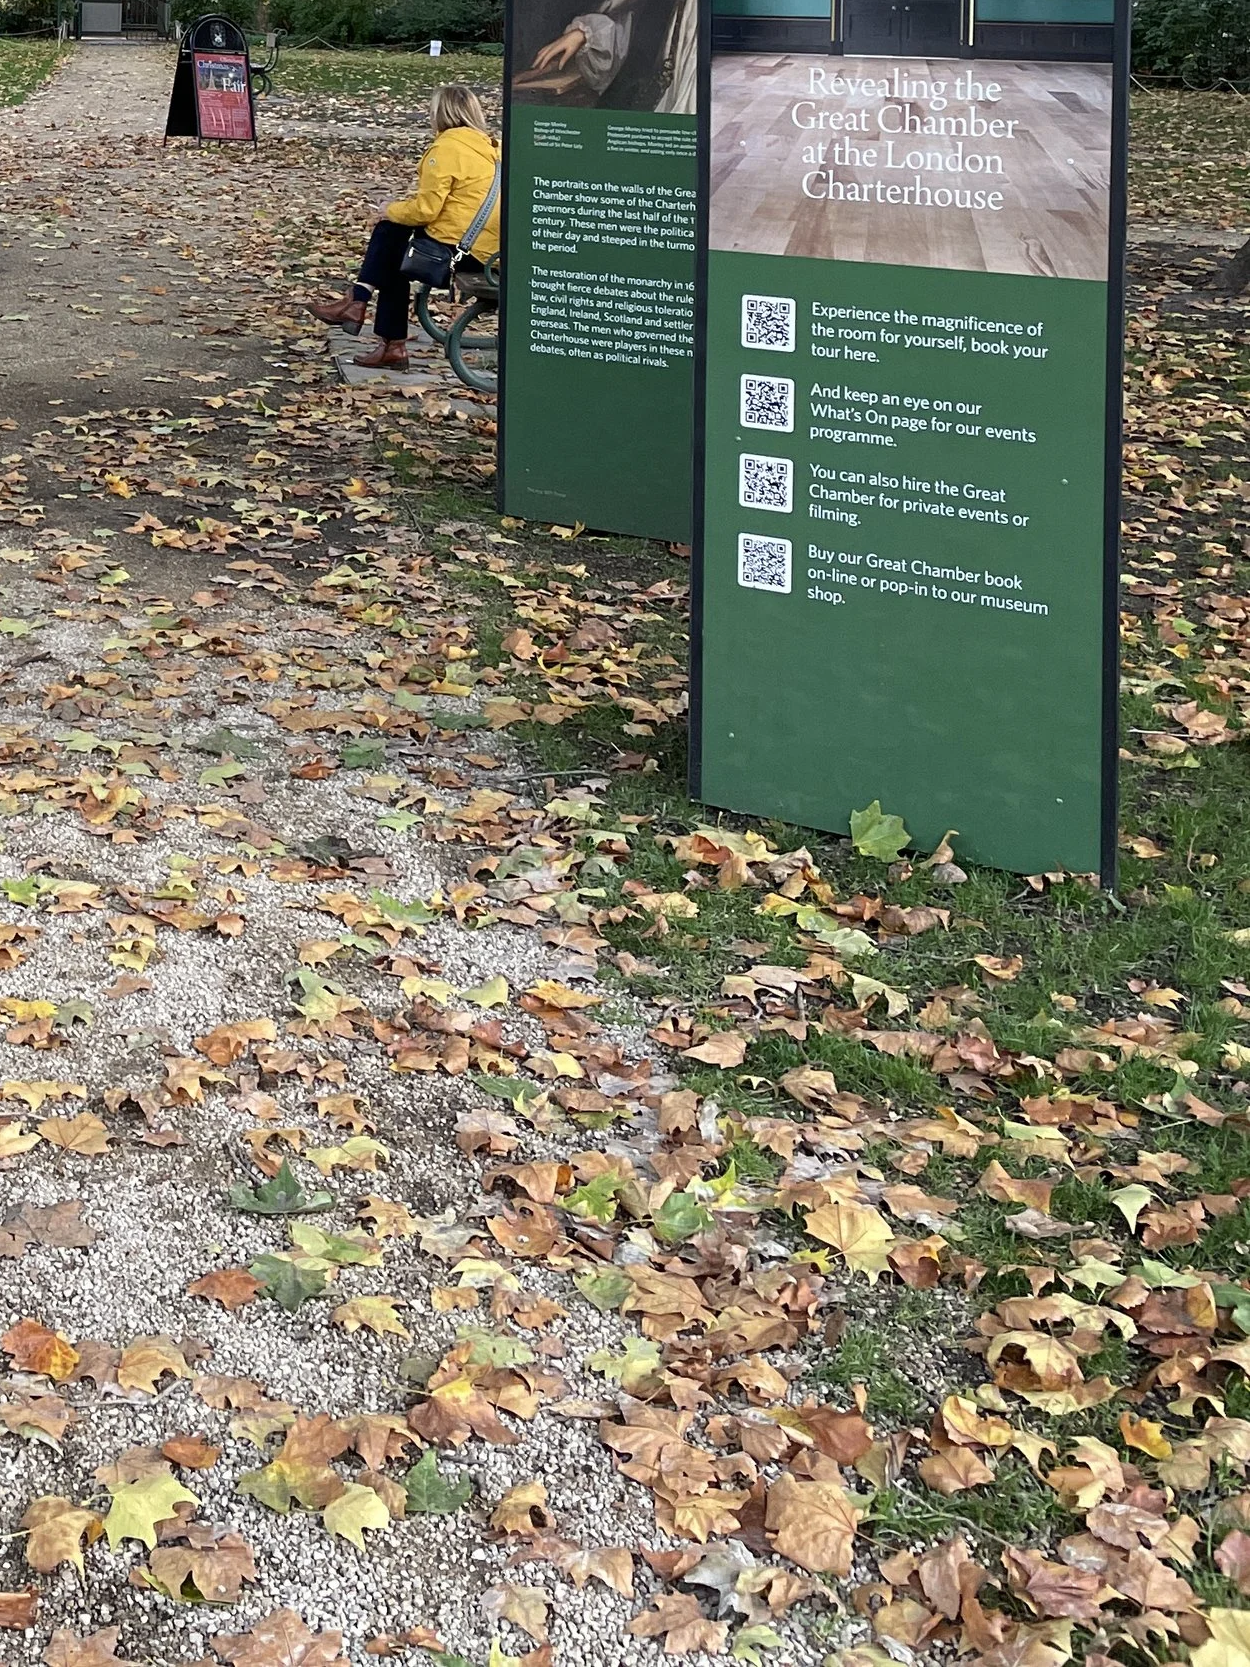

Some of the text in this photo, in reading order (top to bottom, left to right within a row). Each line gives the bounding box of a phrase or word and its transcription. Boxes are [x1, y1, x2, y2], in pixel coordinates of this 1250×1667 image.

[223, 78, 246, 92] Fair
[808, 67, 1002, 111] Revealing the
[791, 102, 1019, 139] Great Chamber
[802, 136, 1004, 174] at the London
[533, 176, 550, 187] The
[551, 180, 589, 189] portraits
[604, 182, 619, 192] the
[621, 184, 644, 194] walls
[646, 185, 655, 194] of
[657, 186, 672, 196] the
[674, 187, 696, 198] Grea
[533, 189, 696, 211] Chamber show some of the Charterh
[802, 171, 1004, 210] Charterhouse
[812, 302, 1043, 336] Experience the magnificence of
[811, 322, 1048, 359] the room for yourself, book your
[811, 343, 879, 362] tour here.
[810, 383, 982, 415] And keep an eye on our
[810, 402, 1036, 442] What's On page for our events
[810, 427, 897, 447] programme.
[809, 463, 1006, 502] You can also hire the Great
[808, 503, 861, 526] filming.
[809, 484, 1029, 526] Chamber for private events or
[808, 544, 1022, 590] Buy our Great Chamber book
[807, 585, 845, 605] shop.
[808, 568, 1048, 615] on-line or pop-in to our museum
